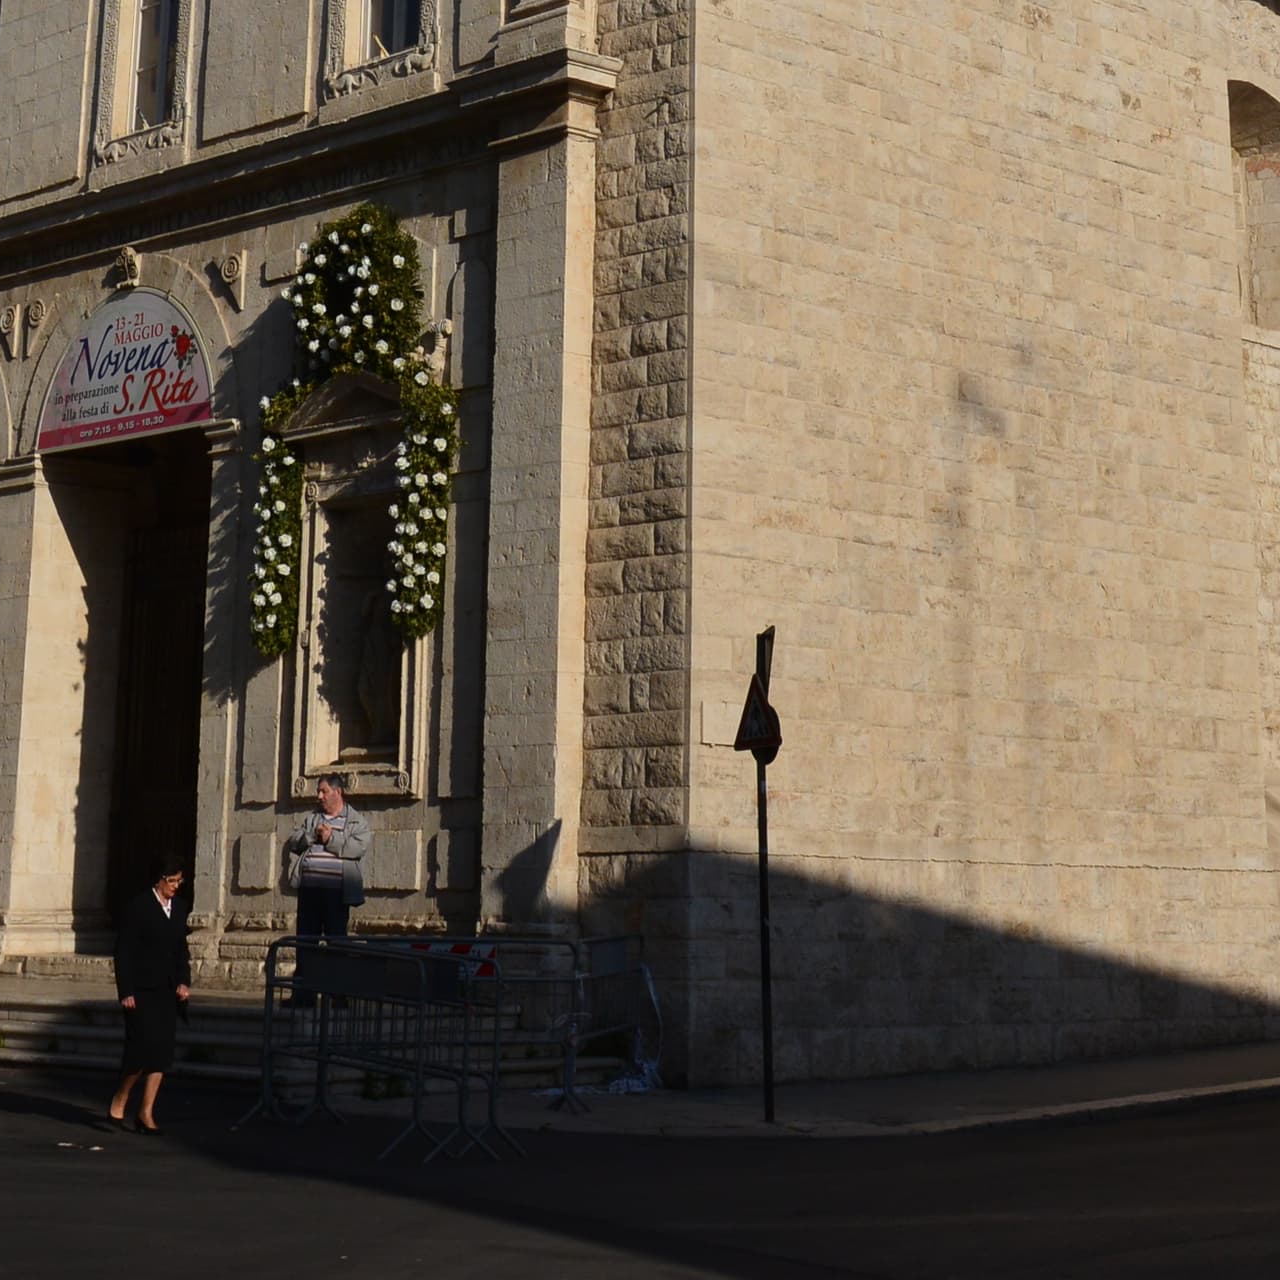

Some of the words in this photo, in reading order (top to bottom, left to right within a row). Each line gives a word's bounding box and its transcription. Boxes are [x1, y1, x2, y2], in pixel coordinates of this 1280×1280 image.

[116, 316, 126, 331] 13
[134, 312, 145, 327] 21
[114, 323, 164, 346] MAGGIO
[70, 324, 174, 386] Novena
[54, 392, 64, 406] in
[63, 382, 120, 407] preparazione
[113, 374, 135, 415] S.
[138, 368, 200, 417] Rita
[62, 407, 78, 422] alla
[78, 404, 99, 420] festa
[100, 401, 109, 415] di
